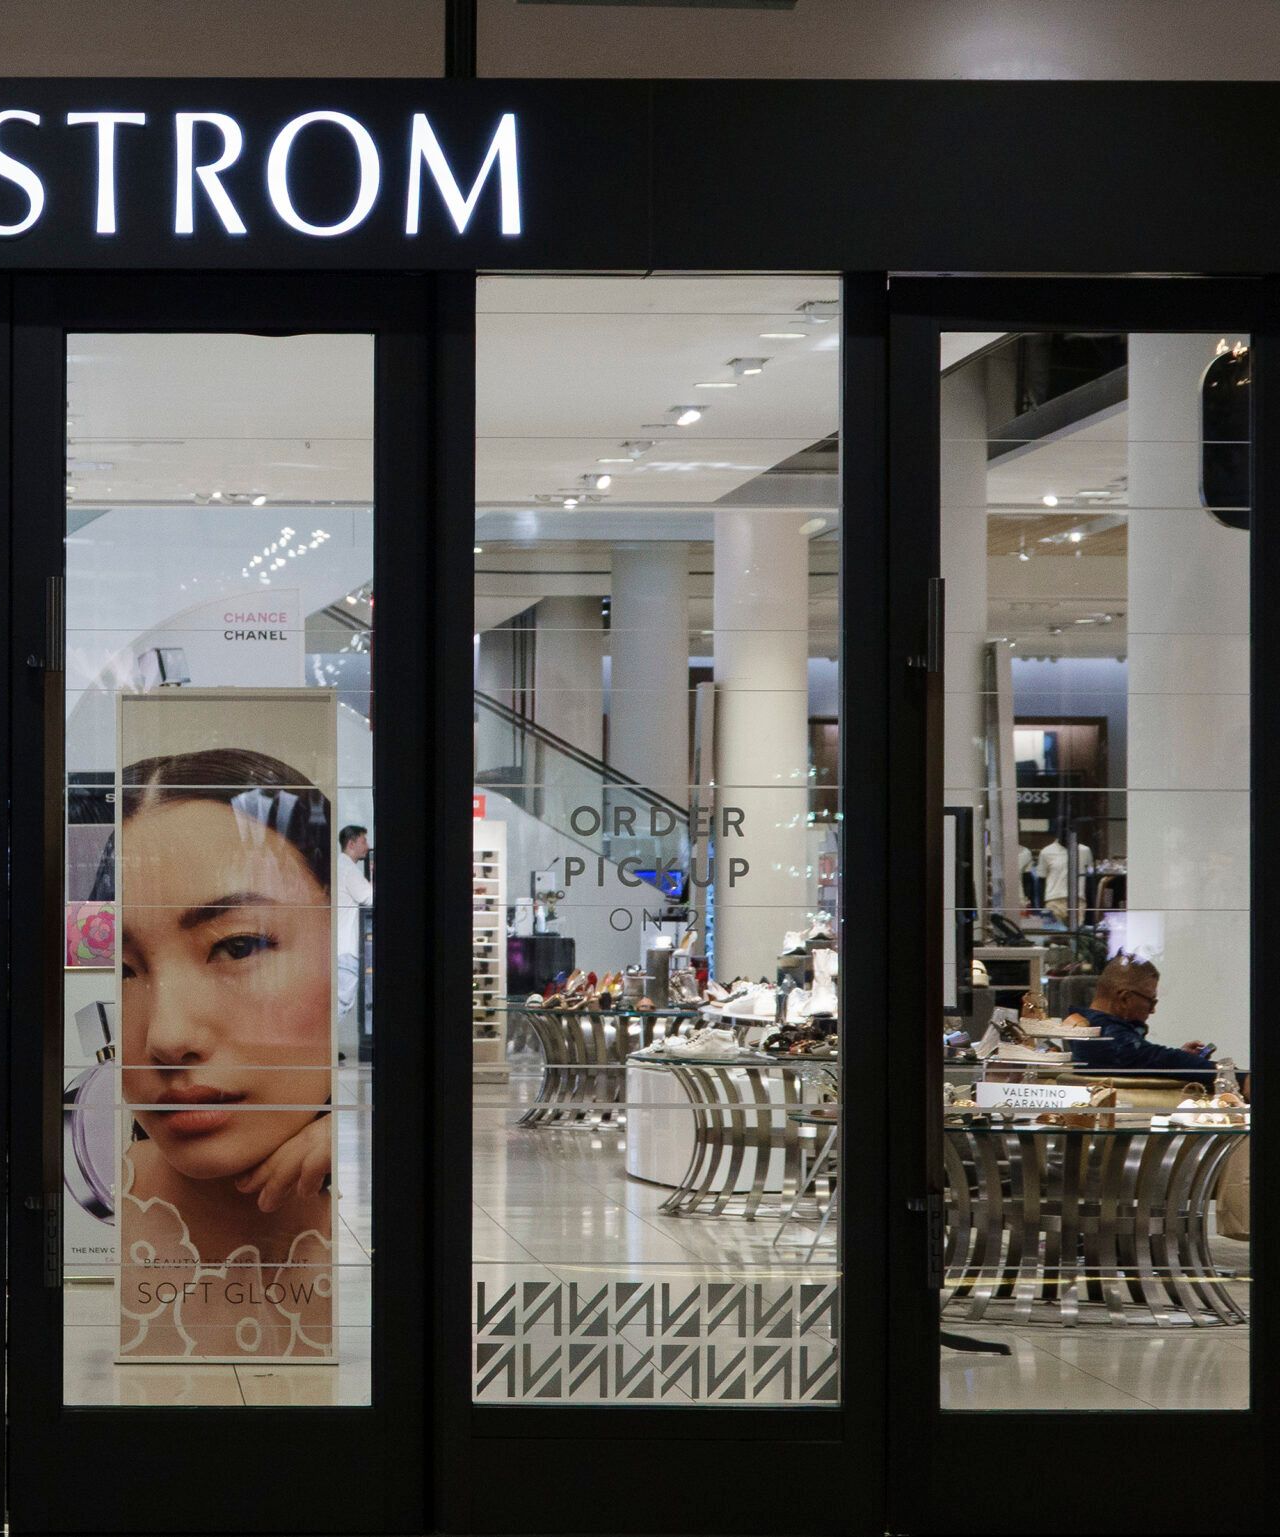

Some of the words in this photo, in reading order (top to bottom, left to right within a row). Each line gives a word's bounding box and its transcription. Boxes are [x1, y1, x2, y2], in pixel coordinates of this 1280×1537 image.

[224, 611, 287, 623] CHANCE
[224, 630, 287, 640] CHANEL
[570, 805, 746, 837] ORDER
[564, 856, 750, 888] PICKUP
[609, 907, 663, 931] ON
[685, 908, 700, 931] 2
[1002, 1086, 1067, 1099] VALENTINO
[137, 1282, 213, 1304] SOFT
[224, 1282, 315, 1305] GLOW
